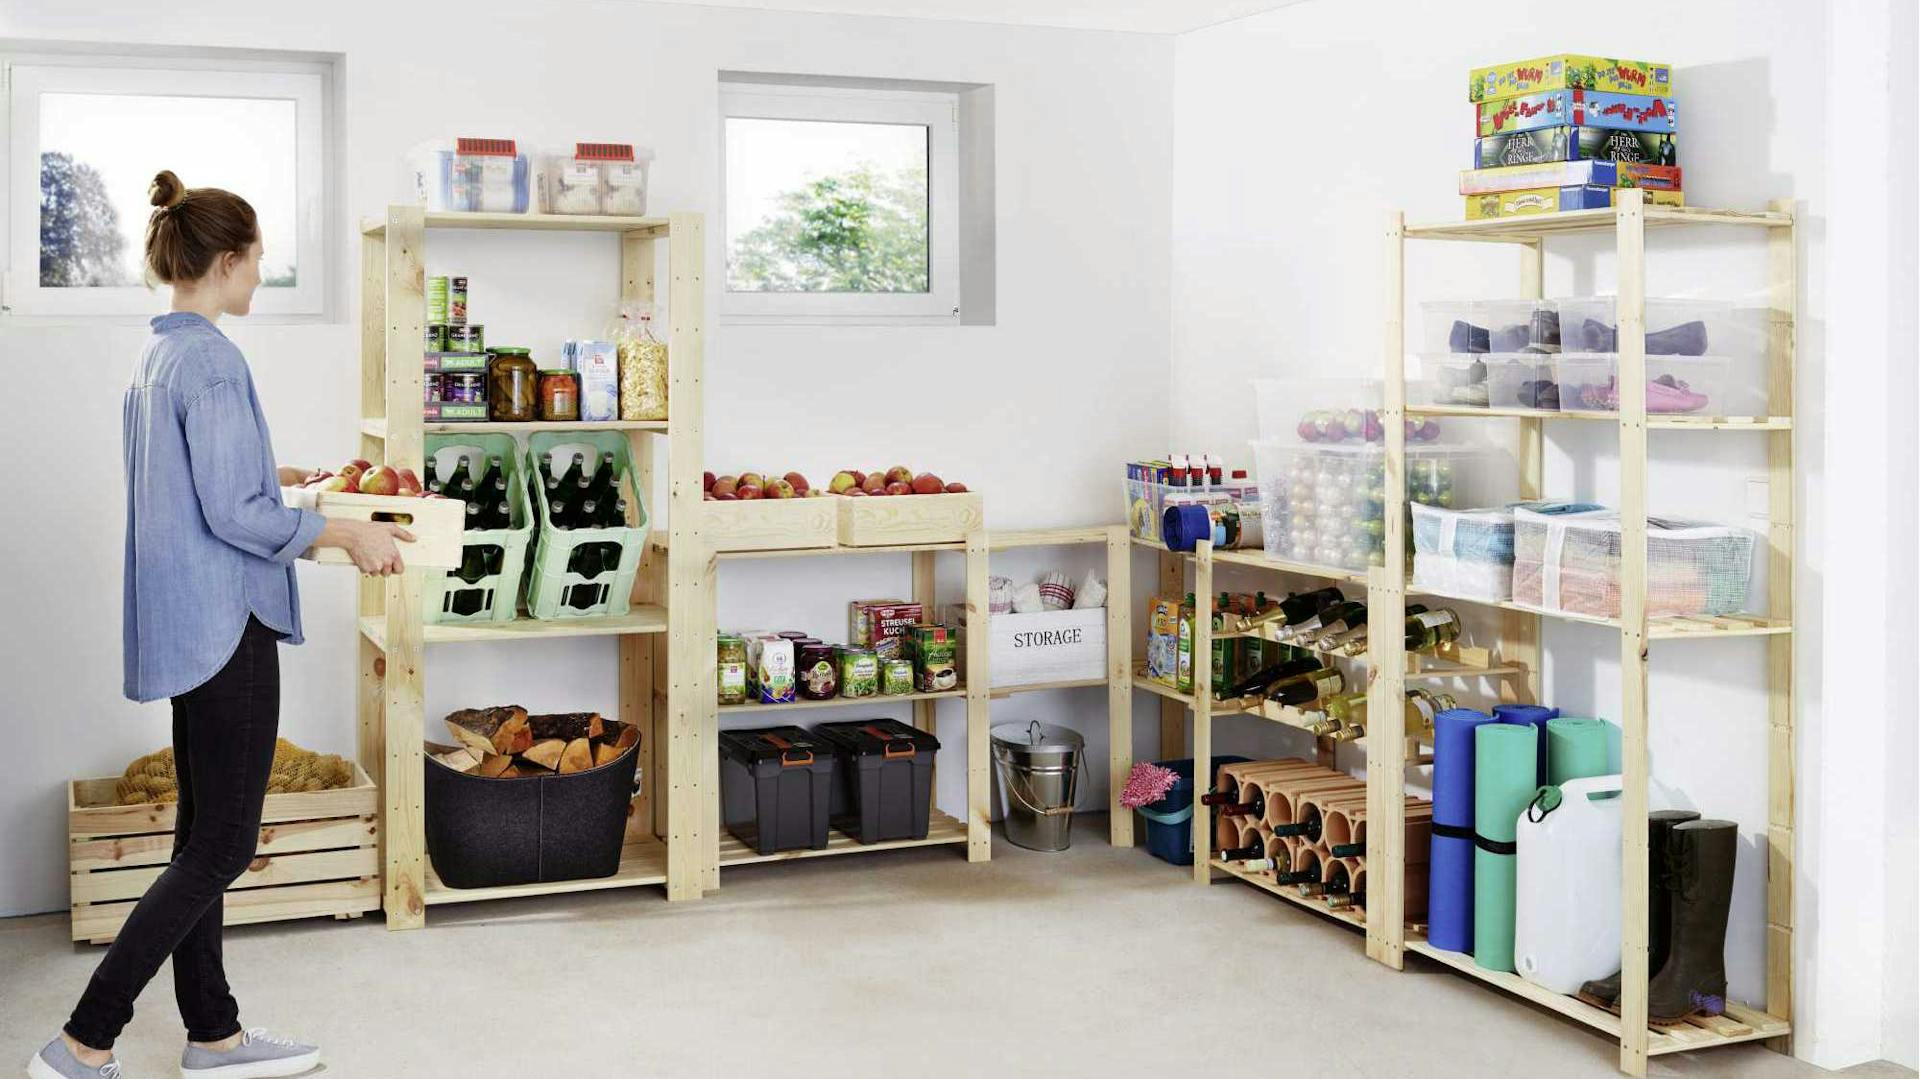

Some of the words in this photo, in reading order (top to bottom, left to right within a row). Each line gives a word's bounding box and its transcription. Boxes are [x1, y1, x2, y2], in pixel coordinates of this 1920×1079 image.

[1610, 135, 1640, 148] HERR
[880, 618, 916, 628] STREUSEL
[883, 627, 906, 635] KUCH
[1014, 628, 1082, 648] STORAGE
